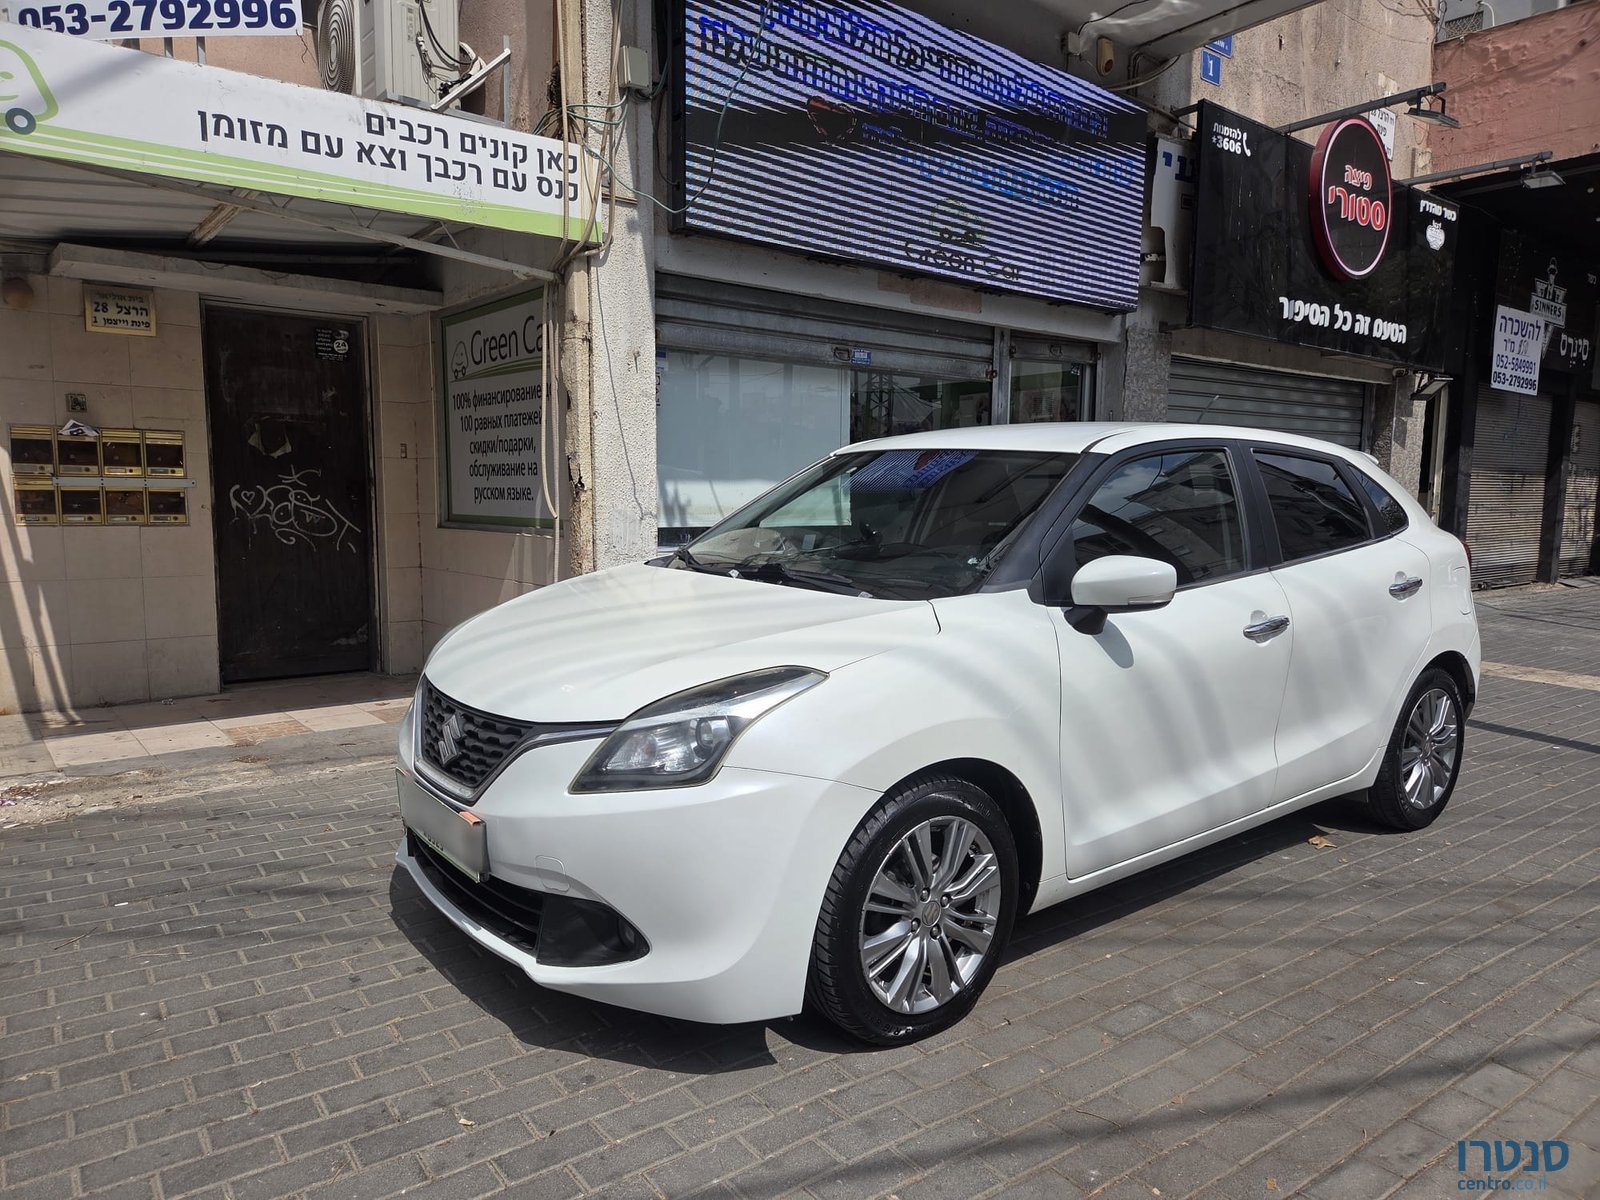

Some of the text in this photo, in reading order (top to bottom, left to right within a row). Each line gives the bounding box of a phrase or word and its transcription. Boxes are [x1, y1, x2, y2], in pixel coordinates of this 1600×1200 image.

[18, 0, 297, 35] 053-2792996
[1213, 122, 1242, 140] להזמנות
[366, 112, 577, 174] כאן קונים רכבים
[197, 110, 578, 201] כנס עם רכבך וצא עם מזומן
[1345, 165, 1372, 190] פיצה
[1328, 185, 1385, 231] סטורי
[1420, 199, 1457, 221] כשר מהדרין
[94, 301, 148, 317] הרצל 28
[1278, 296, 1331, 328] הסיפור
[1333, 303, 1352, 332] כל
[1534, 299, 1562, 318] SINNERS
[131, 319, 151, 328] פינת
[1354, 313, 1371, 336] זה
[1499, 315, 1541, 341] להשכרה
[470, 330, 518, 366] Green
[1492, 371, 1537, 391] 053-2792996
[453, 391, 471, 410] 100%
[460, 415, 473, 432] 100
[474, 415, 502, 435] равных
[469, 434, 536, 457] скидки/подарки,
[469, 459, 538, 482] обслуживание на
[473, 486, 534, 504] русском языке.
